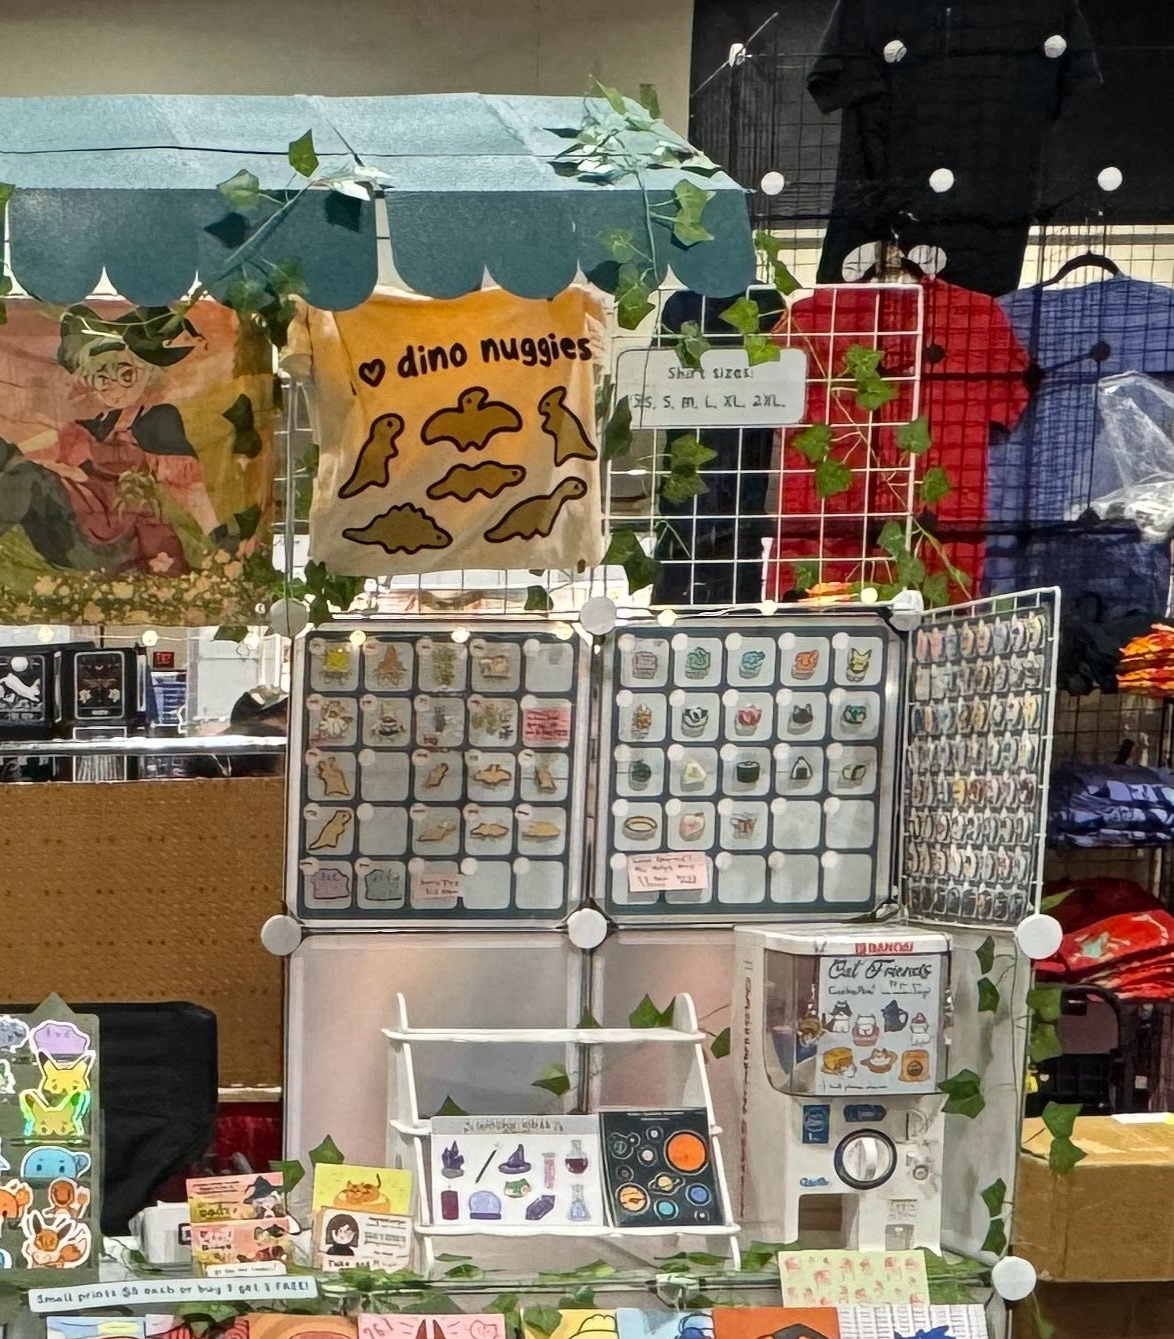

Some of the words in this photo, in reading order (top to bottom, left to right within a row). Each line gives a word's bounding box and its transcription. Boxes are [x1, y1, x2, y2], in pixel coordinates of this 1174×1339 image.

[397, 342, 468, 379] dino
[480, 332, 593, 368] nuggies
[143, 1283, 175, 1296] each
[179, 1285, 193, 1296] or
[197, 1283, 222, 1297] buy
